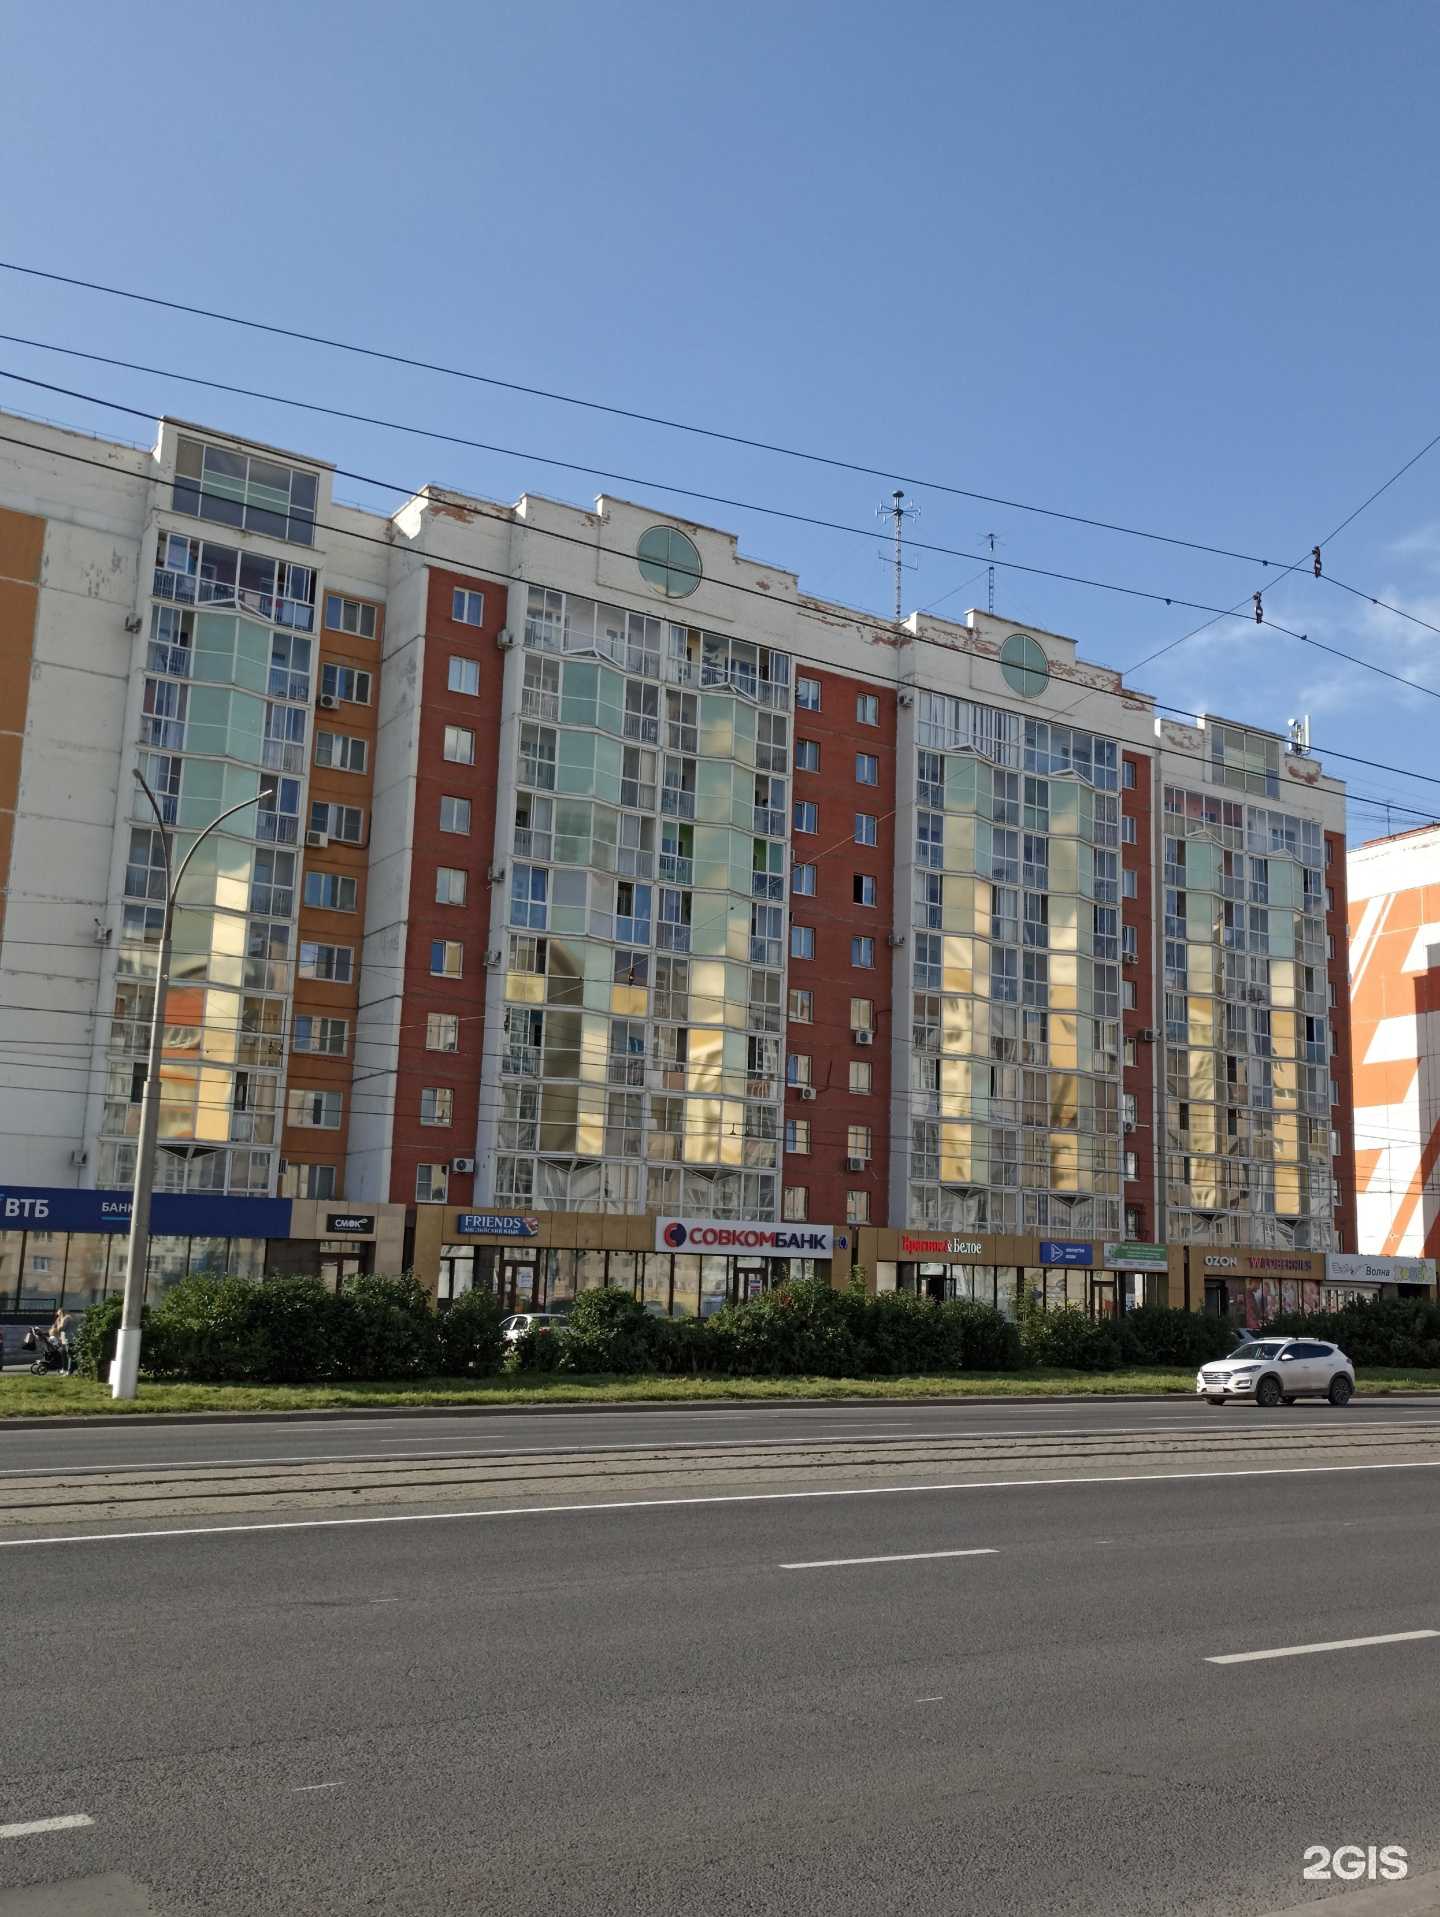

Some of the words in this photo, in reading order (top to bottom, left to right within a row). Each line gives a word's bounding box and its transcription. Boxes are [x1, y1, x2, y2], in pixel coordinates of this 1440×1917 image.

[5, 1198, 49, 1218] ВТБ
[465, 1215, 520, 1229] FRIENDS
[689, 1228, 827, 1250] СОВКОМБАНК
[1205, 1255, 1237, 1267] OZON
[1366, 1266, 1391, 1277] Волна
